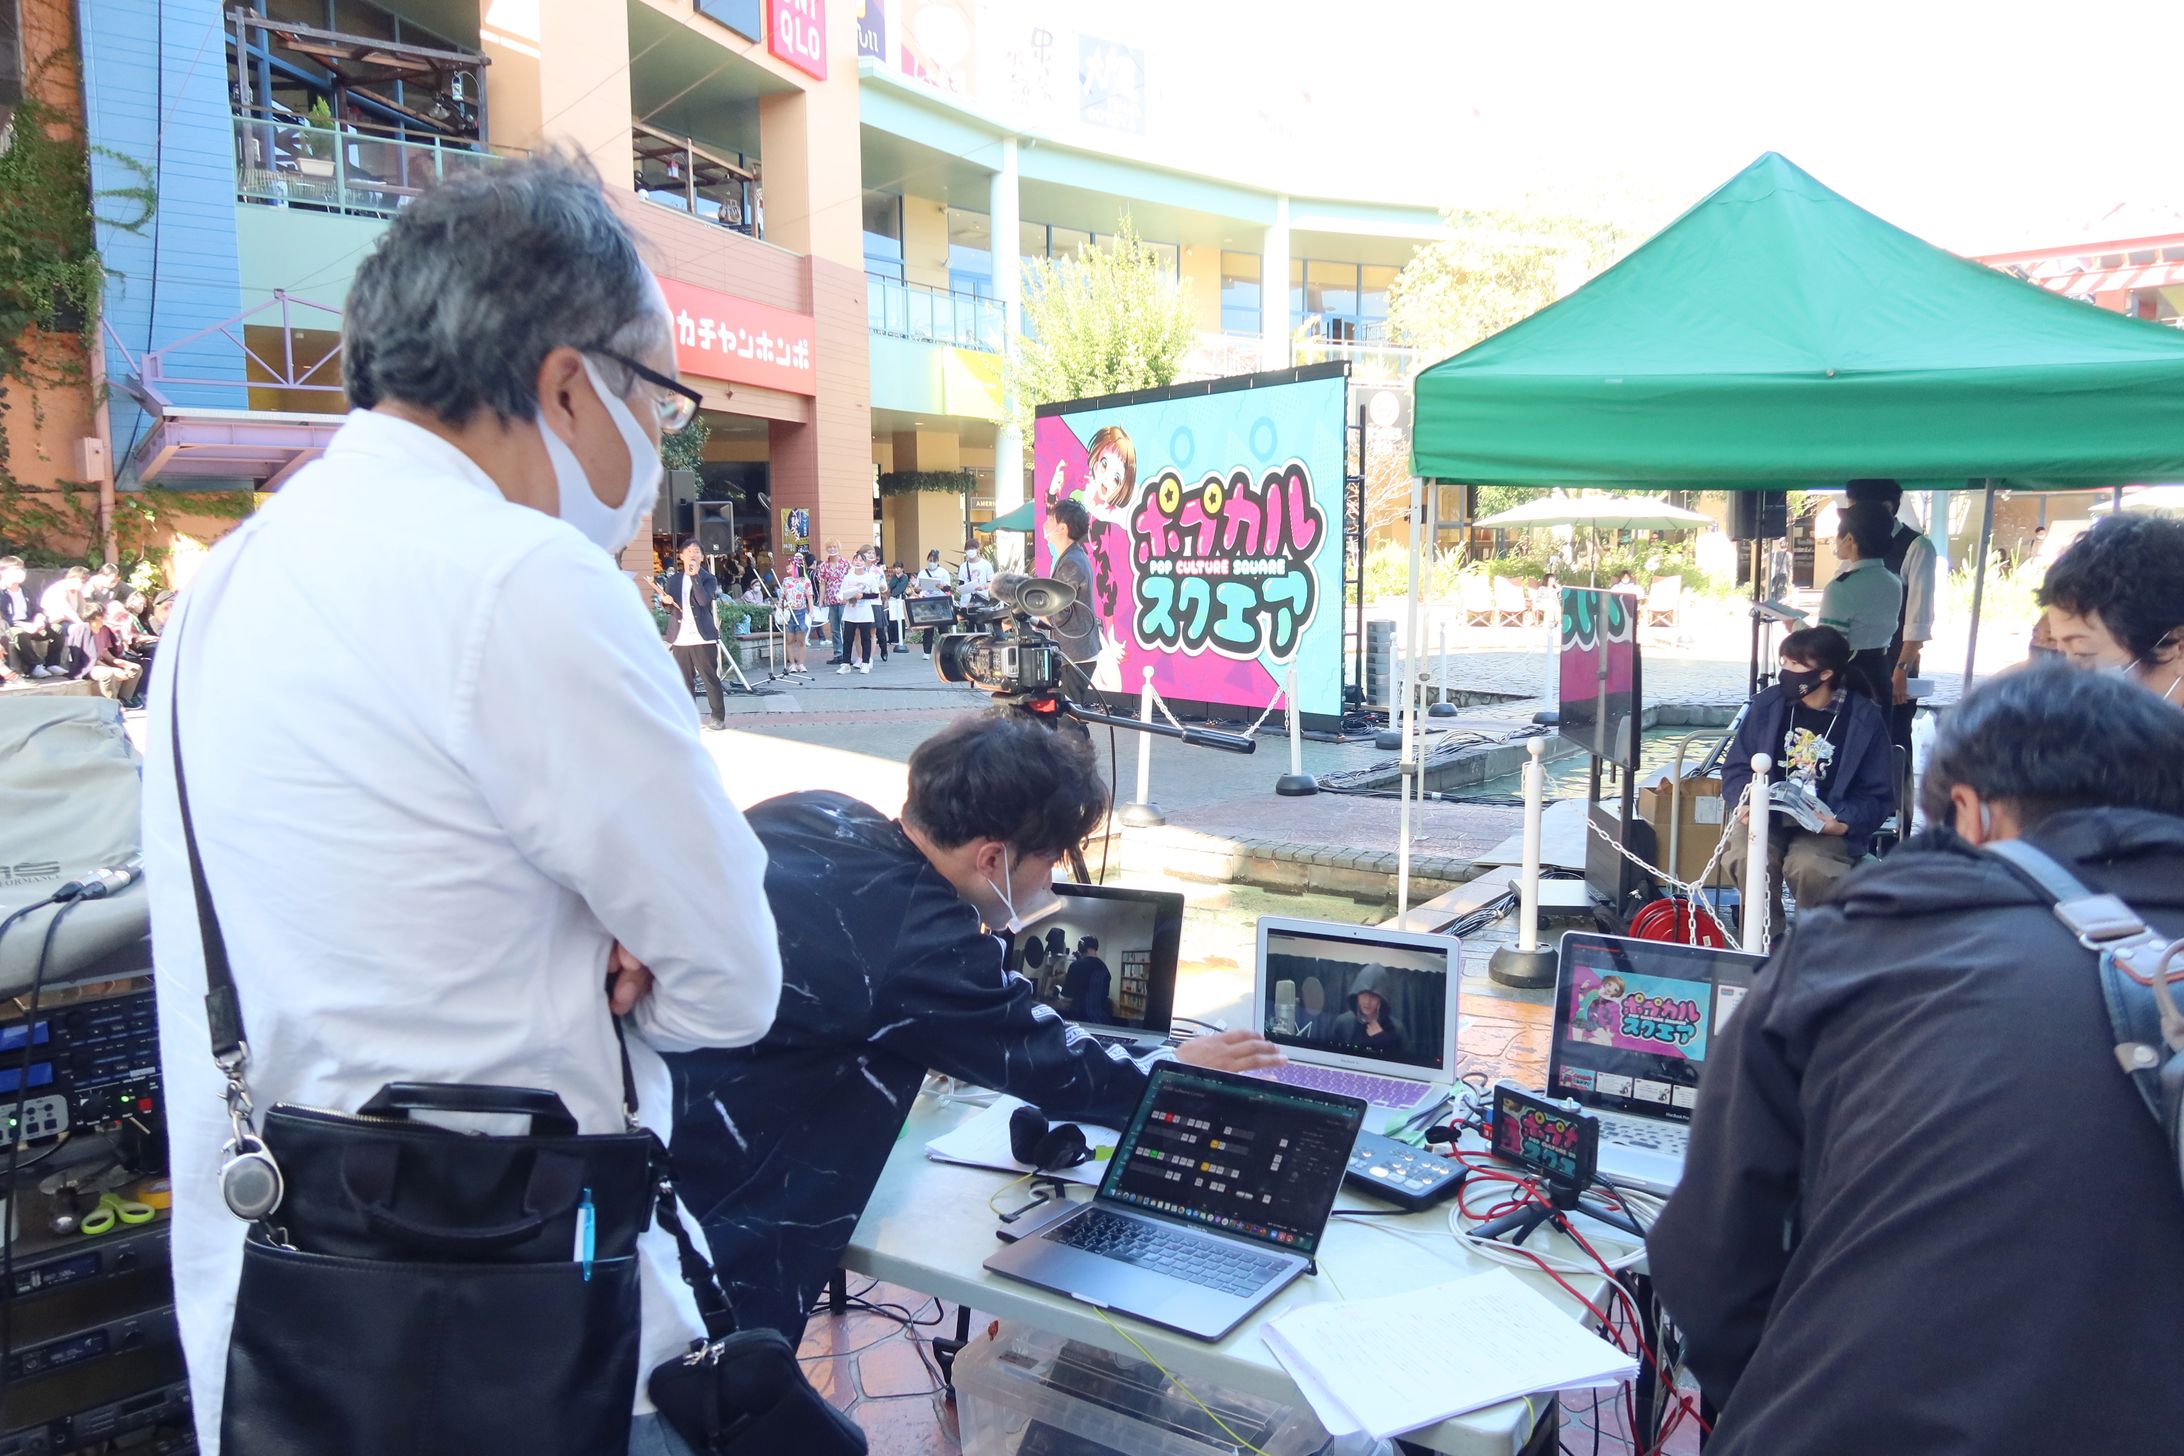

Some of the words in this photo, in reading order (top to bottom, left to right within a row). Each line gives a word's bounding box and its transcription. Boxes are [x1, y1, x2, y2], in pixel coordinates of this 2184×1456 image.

[780, 9, 820, 61] QLO
[1134, 473, 1318, 564] ポプカル
[1149, 559, 1173, 575] POP
[1175, 558, 1230, 575] CULTURE
[1232, 558, 1286, 575] SQUARE
[1141, 569, 1309, 648] スクエア
[1621, 992, 1701, 1023] ポプカル
[1622, 1016, 1696, 1046] スクエア
